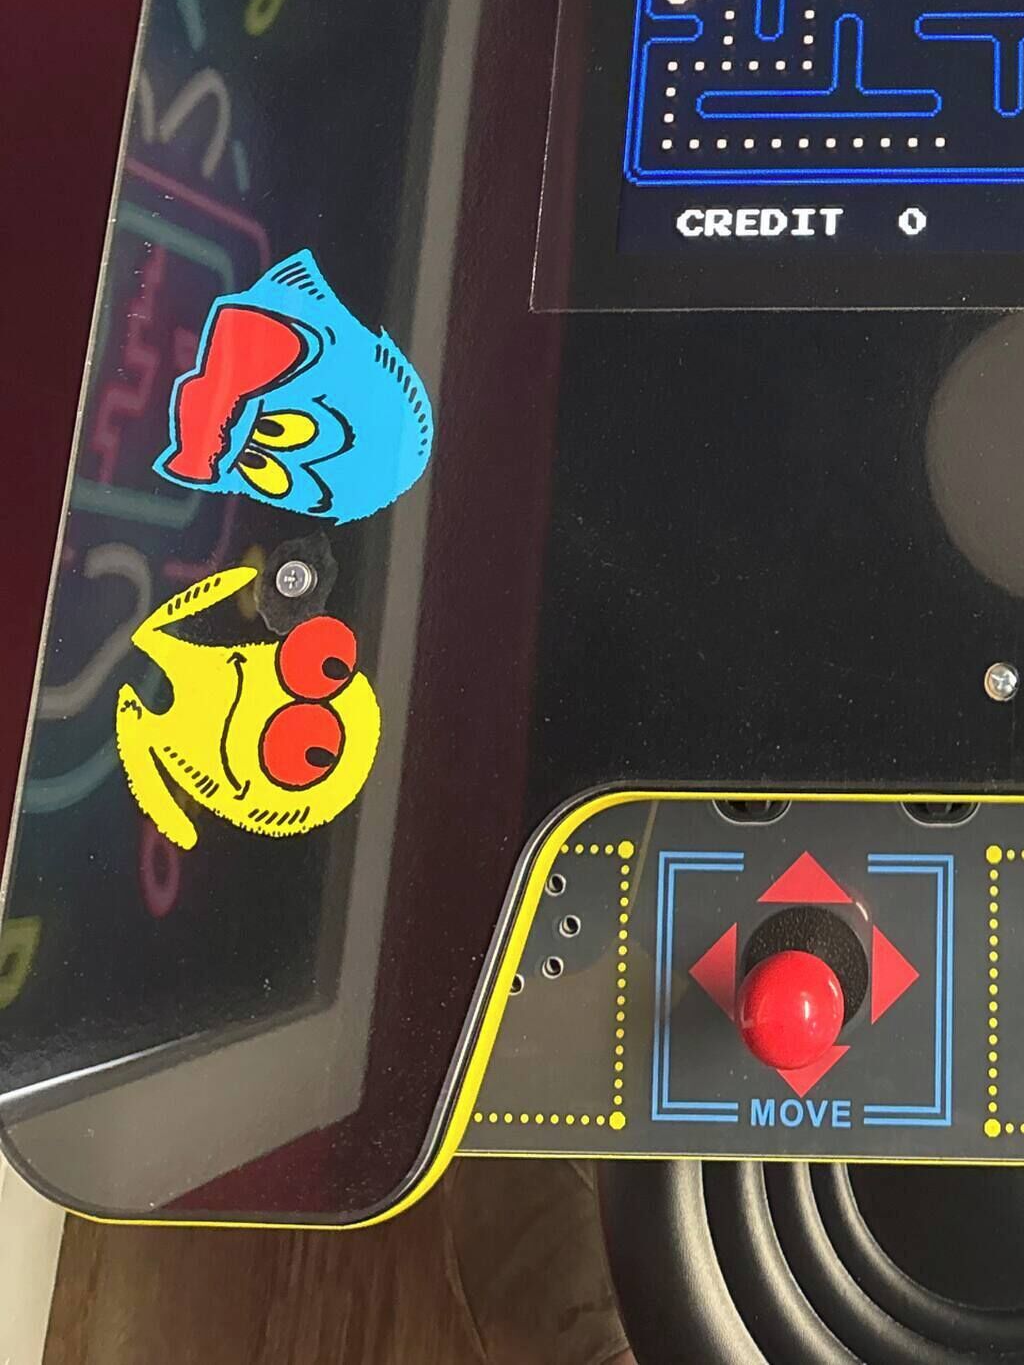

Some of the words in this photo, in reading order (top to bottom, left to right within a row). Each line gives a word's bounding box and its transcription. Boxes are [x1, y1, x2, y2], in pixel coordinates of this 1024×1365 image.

[676, 207, 844, 237] CREDIT
[898, 207, 927, 235] 0
[750, 1098, 852, 1128] MOVE
